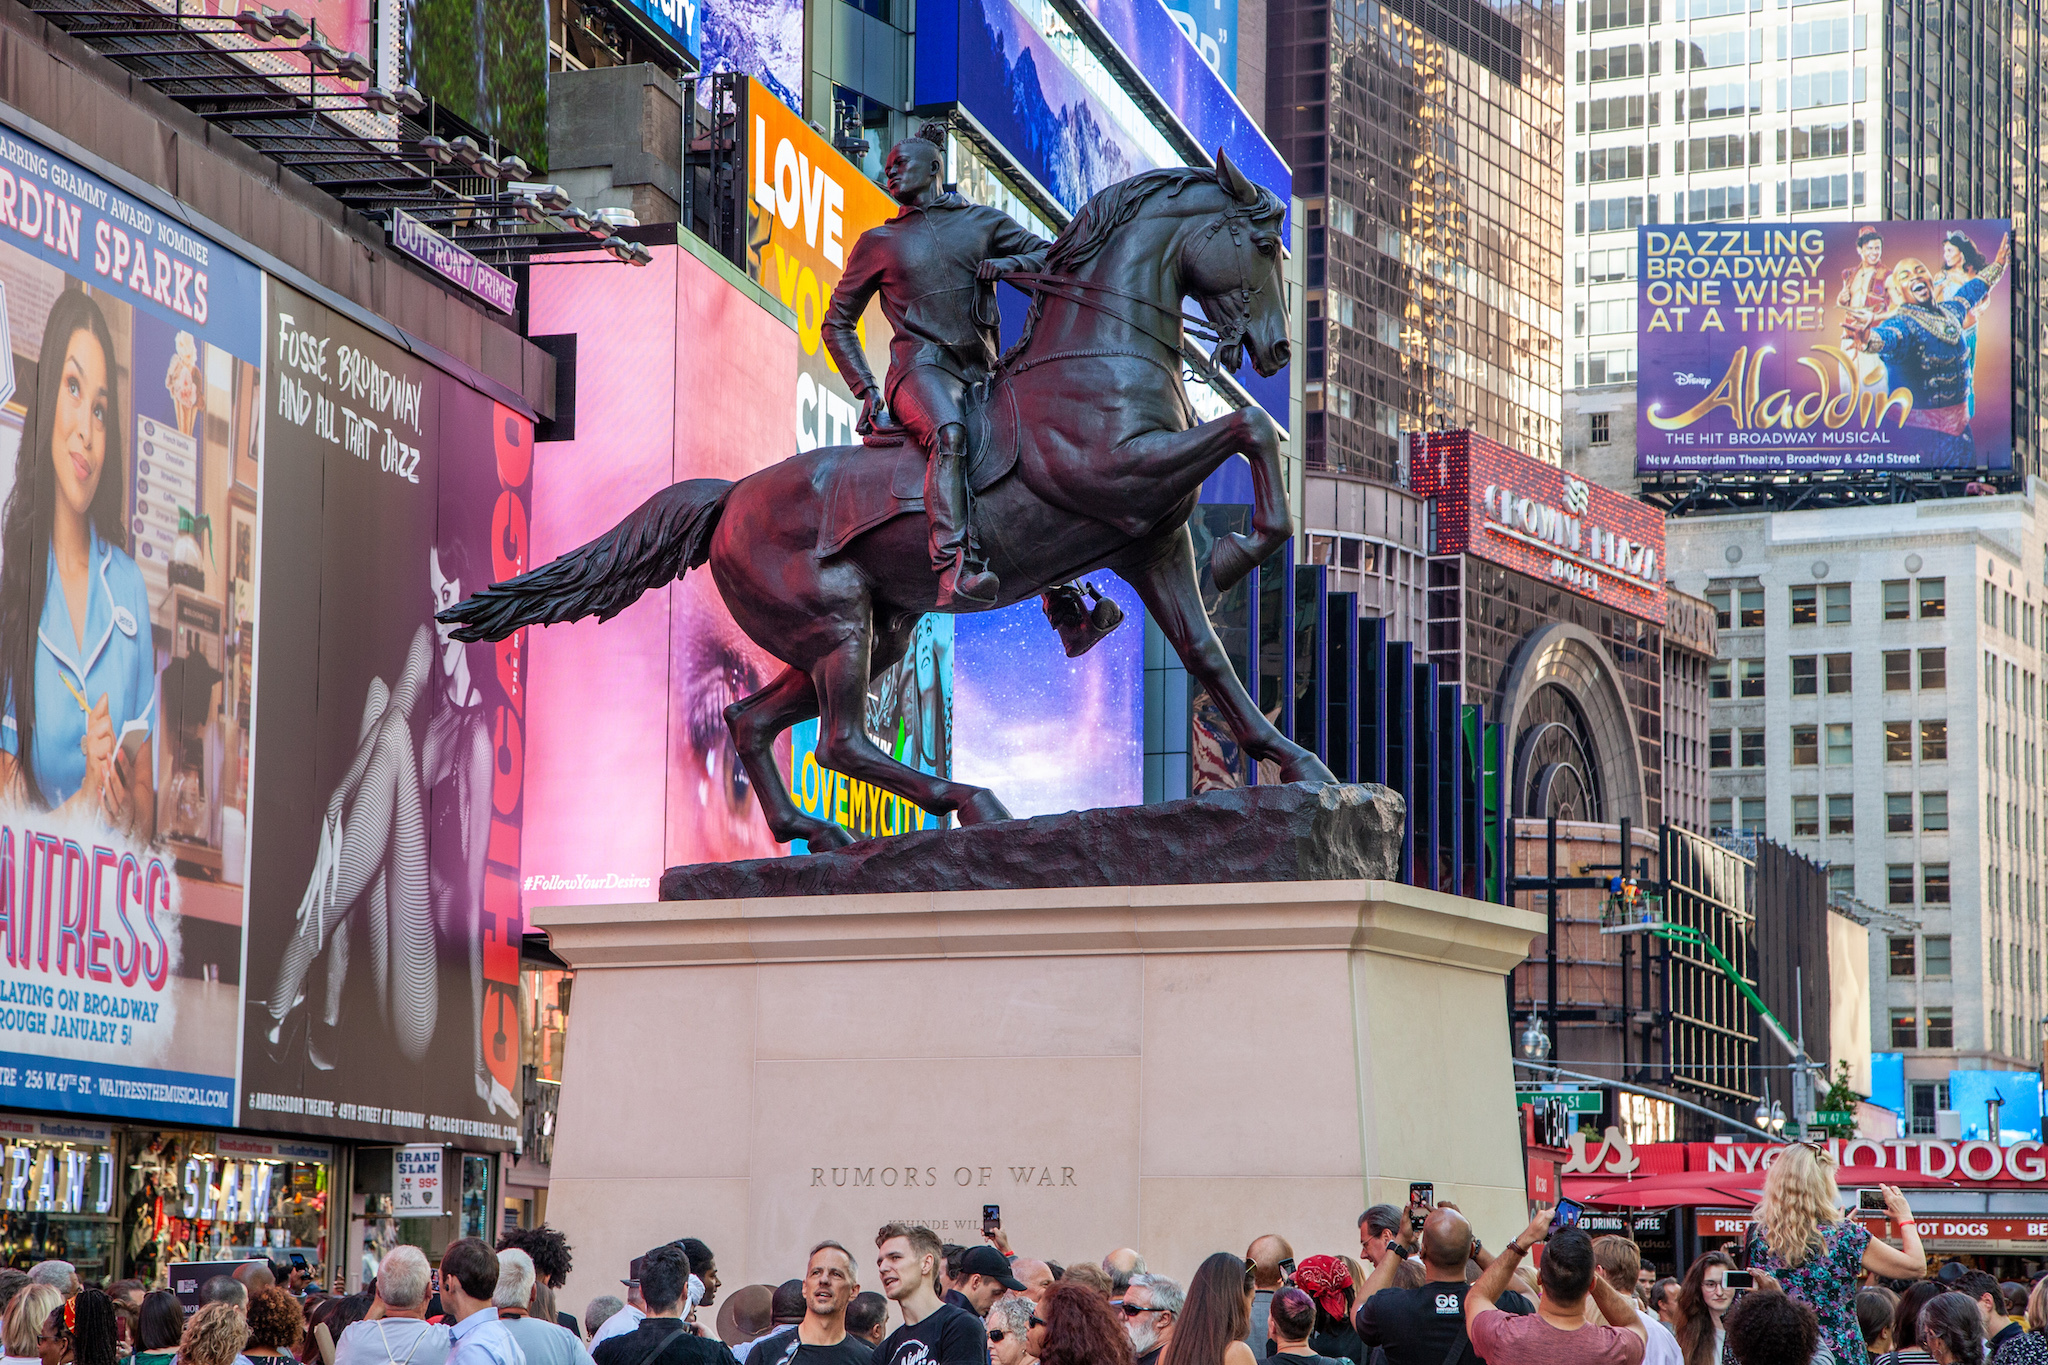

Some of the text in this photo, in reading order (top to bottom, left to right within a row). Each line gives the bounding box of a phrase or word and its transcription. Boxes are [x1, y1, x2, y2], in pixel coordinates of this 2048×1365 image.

[756, 114, 844, 270] LOVE
[51, 164, 107, 211] GRAMMY
[158, 222, 209, 266] NOMINEE
[1647, 230, 1825, 256] DAZZLING
[95, 219, 209, 325] SPARKS
[399, 217, 471, 284] OUTFRONT
[477, 266, 512, 307] PRIME
[1647, 256, 1825, 279] BROADWAY
[1647, 279, 1825, 306] ONE WISH
[1647, 305, 1825, 332] AT A TIME!
[1647, 344, 1914, 430] Aladdin
[1673, 371, 1712, 389] Disney
[278, 372, 421, 483] AND ALL THAT JAZZ
[1665, 431, 1890, 444] THE HIT BROADWAY MUSICAL
[1646, 455, 1670, 465] New
[1673, 453, 1737, 466] Amsterdam
[1786, 453, 1842, 468] Broadway
[1845, 454, 1853, 464] &
[1855, 453, 1884, 464] 42nd
[1886, 452, 1921, 465] Street
[791, 744, 926, 838] LOVEMYCITY
[523, 873, 651, 891] #FollowYourDesires
[58, 988, 79, 1013] ON
[84, 993, 159, 1024] BROADWAY
[51, 1015, 116, 1044] JANUARY
[121, 1026, 132, 1046] 5!
[25, 1069, 43, 1089] 256
[98, 1078, 228, 1108] WAITRESSTHEMUSICAL.COM
[1568, 1095, 1580, 1108] St
[256, 1092, 518, 1142] AMBASSADOR THEATRE 49TH STREET AT BROADWAY CHICAGOTHEMUSICAL.COM
[1818, 1113, 1827, 1122] W
[1830, 1113, 1840, 1122] 47
[395, 1152, 440, 1163] GRAND
[398, 1163, 437, 1174] SLAM
[810, 1166, 1078, 1188] RUMORS OF WAR
[1592, 1218, 1623, 1230] DRINKS
[1635, 1218, 1660, 1230] OFFEE
[1916, 1222, 1939, 1236] OT
[1943, 1222, 1989, 1237] DOGS
